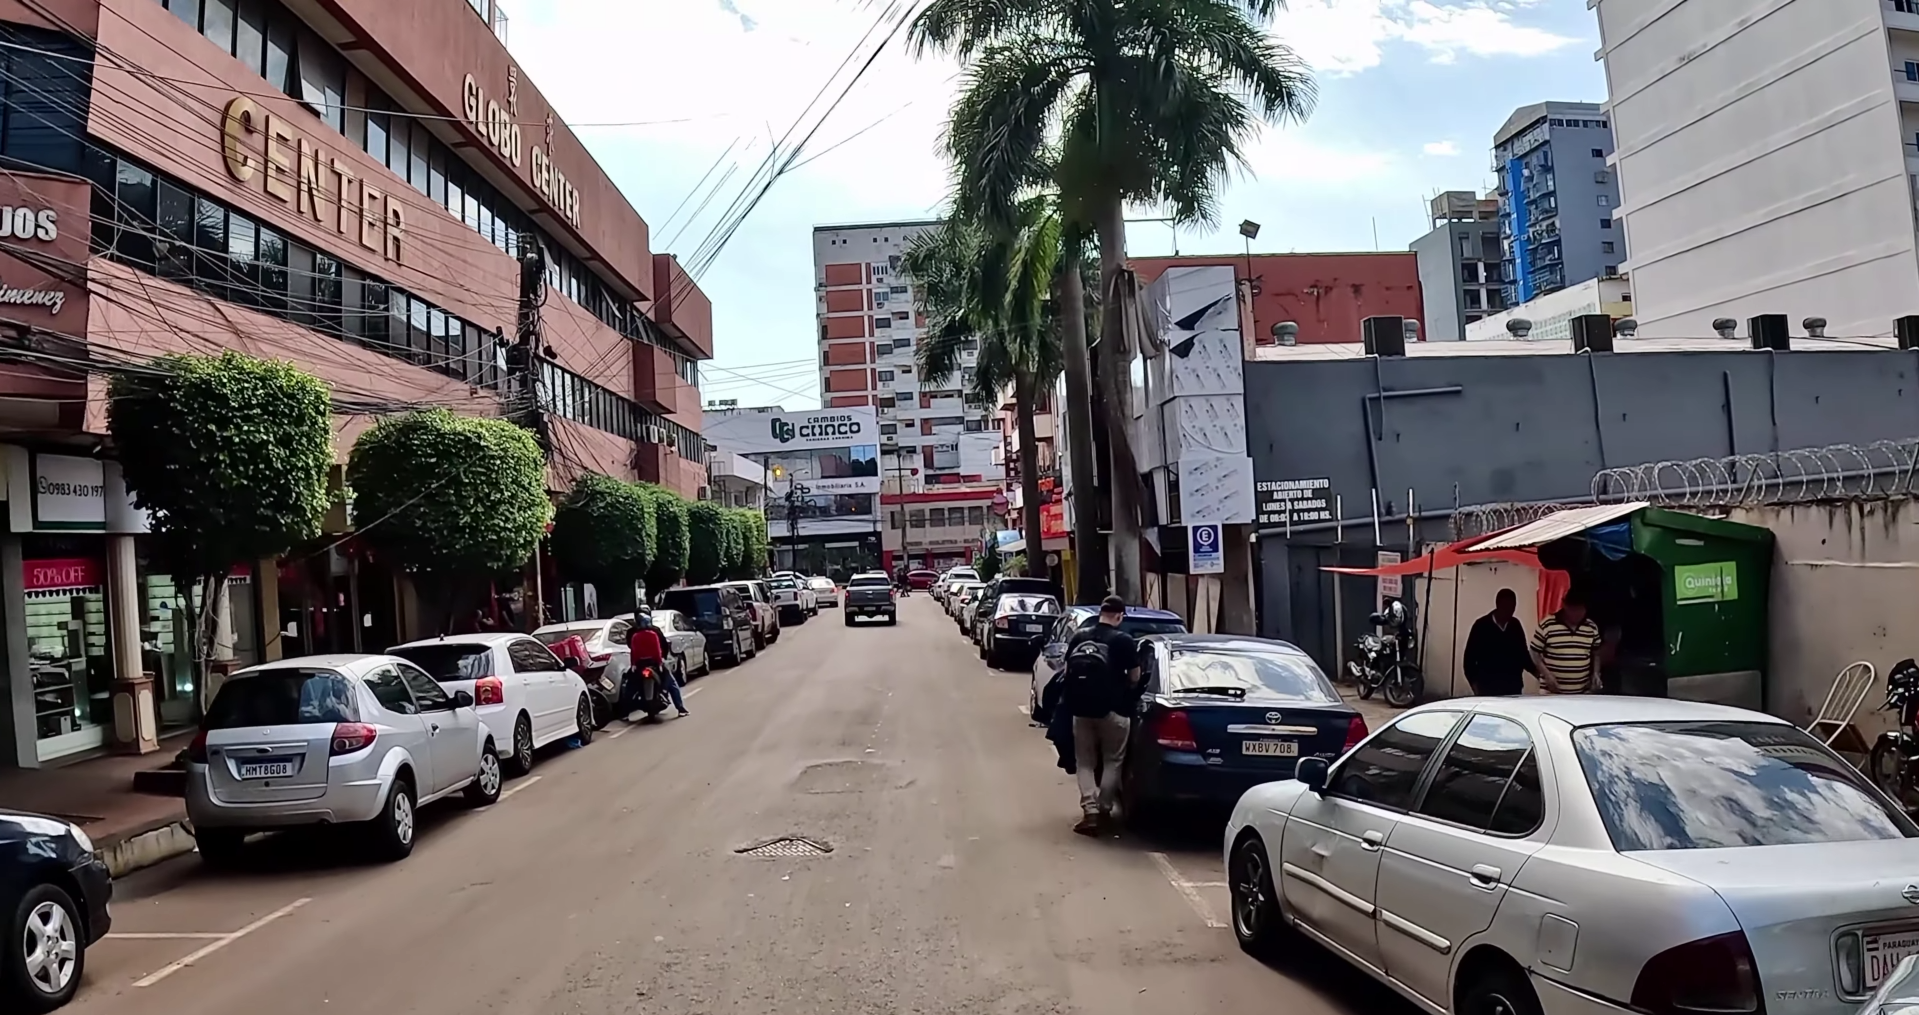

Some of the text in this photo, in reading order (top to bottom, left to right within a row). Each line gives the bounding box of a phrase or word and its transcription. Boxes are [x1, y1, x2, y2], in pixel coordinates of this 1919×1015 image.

[463, 73, 581, 229] GLOBO CENTER
[220, 96, 406, 267] CENTER
[807, 415, 852, 424] CAMBIOS
[48, 483, 104, 498] 0983 430 197
[1257, 479, 1329, 491] ESTACIONAMIENTO
[1273, 489, 1313, 499] ABIERTO DE
[1263, 502, 1285, 511] LUNES
[1294, 499, 1326, 509] SABADOS
[1259, 514, 1269, 523] DE
[1293, 512, 1299, 521] A
[1202, 530, 1209, 541] E
[33, 566, 85, 586] 50% OFF
[1245, 742, 1270, 752] WXBV
[245, 764, 287, 776] HMT8G08
[1775, 988, 1830, 1000] SENTRA
